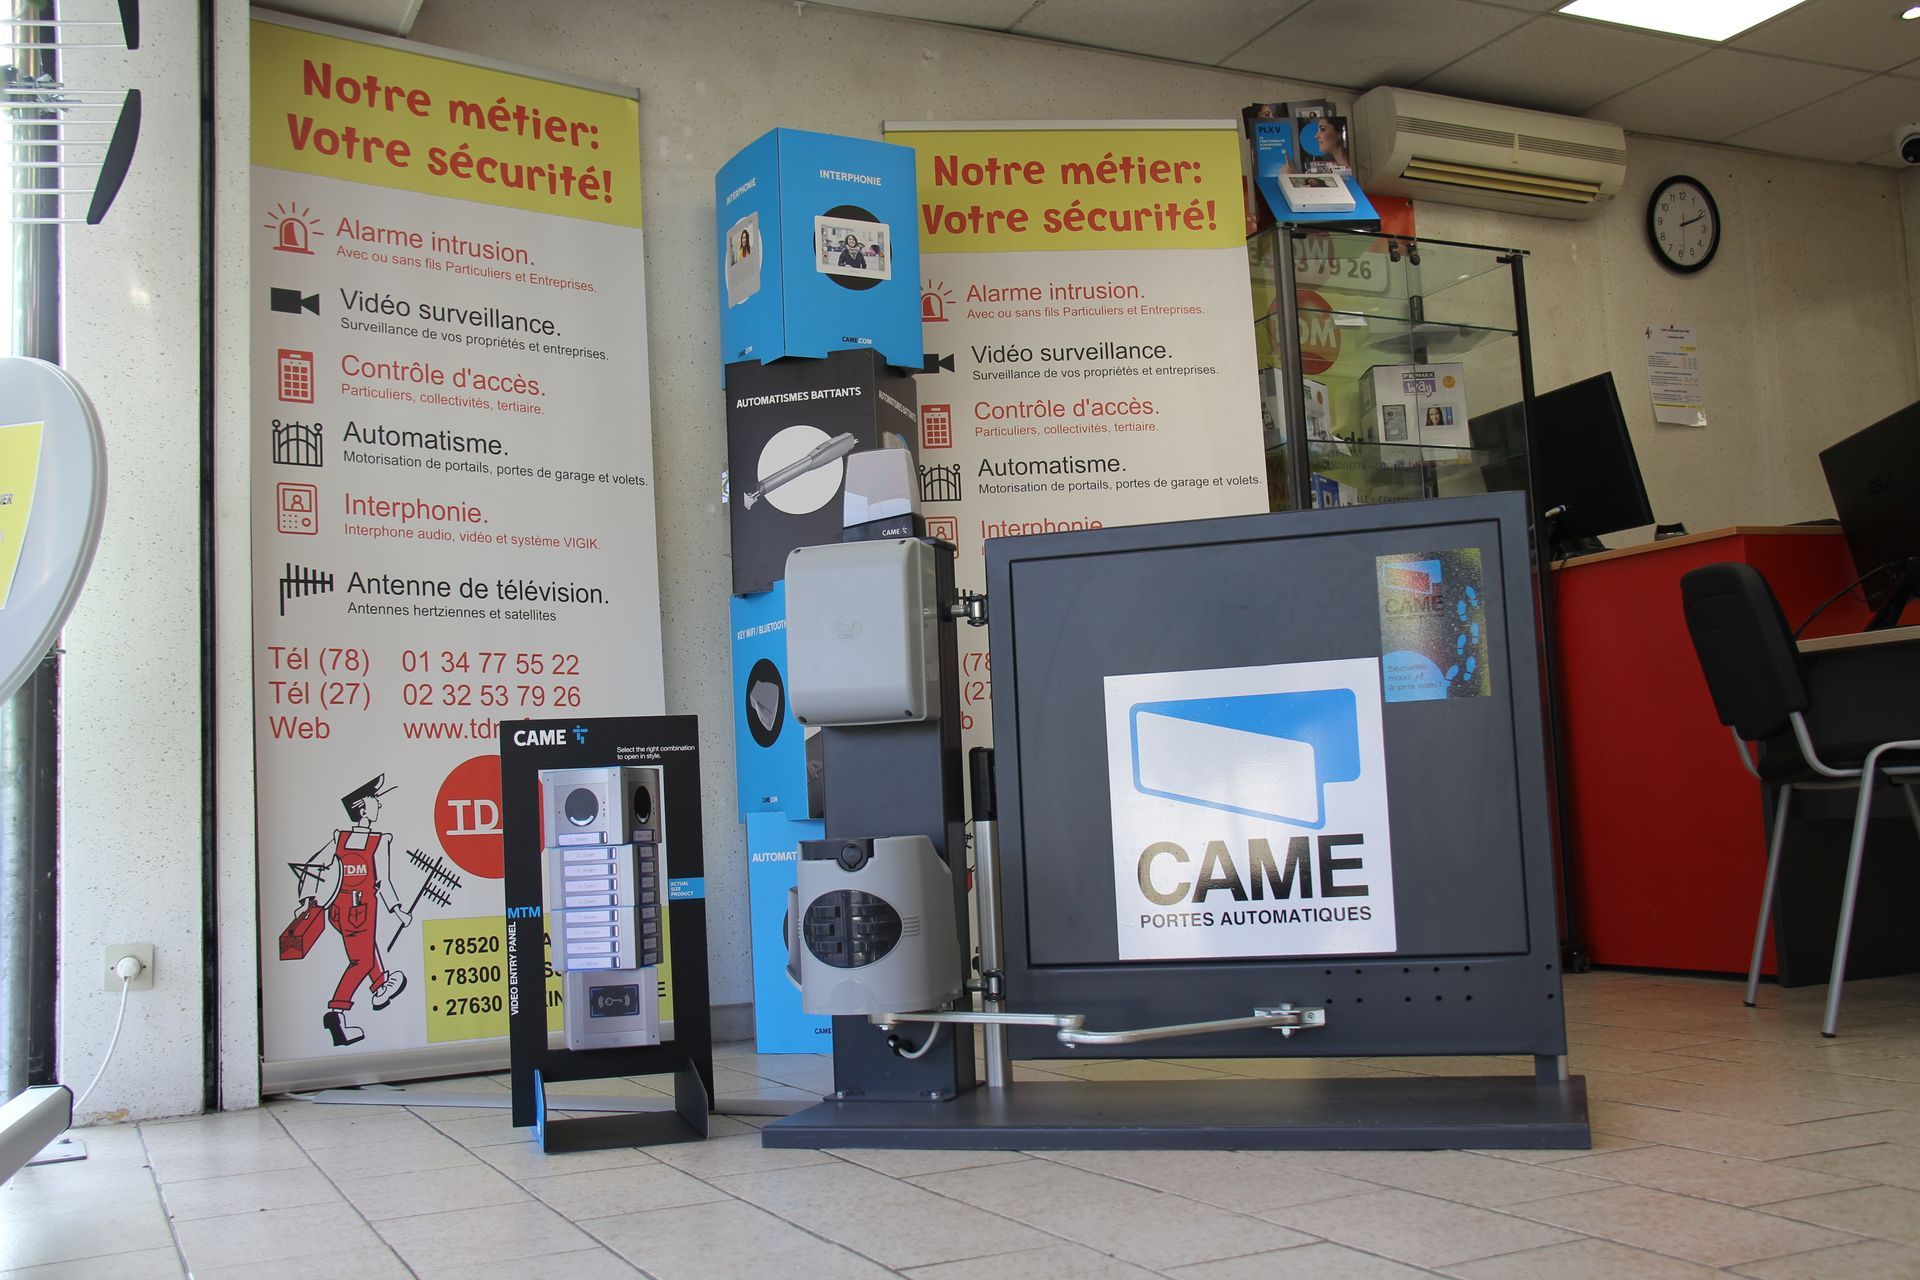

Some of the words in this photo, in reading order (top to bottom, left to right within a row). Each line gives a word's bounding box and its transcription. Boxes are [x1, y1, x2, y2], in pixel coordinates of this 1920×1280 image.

[303, 59, 431, 117] Notre
[449, 97, 599, 150] métier:
[1259, 126, 1274, 134] PLX
[287, 113, 411, 167] Votre
[428, 143, 612, 203] sécurité!
[934, 155, 1045, 187] Notre
[1061, 152, 1202, 185] métier:
[819, 168, 882, 187] INTERPHONIE
[726, 177, 756, 206] INTERPHONIE
[922, 203, 1029, 235] Votre
[1043, 199, 1217, 234] sécurité!
[336, 217, 422, 249] Alarme
[431, 231, 535, 265] intrusion.
[336, 246, 368, 261] Avec
[372, 252, 387, 264] ou
[391, 254, 421, 268] sans
[425, 256, 441, 271] fils
[445, 260, 512, 280] Particuliers
[515, 270, 527, 283] et
[529, 272, 597, 293] Entreprises.
[1347, 260, 1372, 280] 26
[966, 283, 1042, 302] Alarme
[1049, 282, 1145, 301] intrusion.
[340, 287, 411, 317] Vidéo
[419, 303, 561, 336] surveillance.
[967, 307, 995, 320] Avec
[997, 309, 1012, 319] ou
[1015, 308, 1042, 319] sans
[1044, 306, 1060, 318] fils
[1063, 305, 1124, 318] Particuliers
[1126, 305, 1138, 316] et
[1140, 304, 1205, 319] Entreprises.
[341, 317, 418, 337] Surveillance
[422, 326, 437, 339] de
[441, 330, 462, 342] vos
[466, 331, 525, 353] propriétés
[529, 339, 540, 353] et
[542, 341, 609, 362] entreprises.
[842, 335, 872, 345] CAME.COM
[971, 344, 1034, 364] Vidéo
[1040, 342, 1173, 363] surveillance.
[341, 354, 445, 385] Contrôle
[453, 367, 546, 397] d'accès.
[972, 367, 1041, 381] Surveillance
[1044, 368, 1058, 379] de
[1060, 369, 1081, 379] vos
[1083, 365, 1139, 379] propriétés
[1142, 366, 1153, 377] et
[1156, 364, 1219, 379] entreprises.
[341, 383, 416, 403] Particuliers,
[420, 392, 493, 412] collectivités,
[497, 400, 544, 415] tertiaire.
[736, 391, 809, 409] AUTOMATISMES
[811, 386, 862, 401] BATTANTS
[974, 400, 1065, 420] Contrôle
[1073, 397, 1160, 417] d'accès.
[343, 421, 509, 456] Automatisme.
[975, 424, 1040, 438] Particuliers,
[1044, 422, 1111, 437] collectivités,
[1114, 421, 1159, 433] tertiaire.
[344, 450, 421, 468] Motorisation
[425, 455, 441, 469] de
[445, 458, 493, 477] portails,
[497, 463, 533, 478] portes
[537, 466, 551, 479] de
[555, 470, 595, 484] garage
[599, 471, 610, 484] et
[612, 472, 649, 487] volets.
[978, 455, 1127, 478] Automatisme.
[979, 481, 1048, 494] Motorisation
[1050, 481, 1065, 492] de
[1068, 479, 1112, 493] portails,
[1115, 478, 1151, 491] portes
[1153, 477, 1168, 488] de
[1171, 478, 1209, 490] garage
[1212, 476, 1223, 487] et
[1226, 475, 1262, 488] volets.
[344, 493, 488, 524] Interphonie.
[344, 523, 414, 541] Interphone
[418, 527, 456, 543] audio,
[460, 529, 492, 543] vidéo
[496, 532, 508, 545] et
[511, 533, 560, 551] système
[564, 535, 602, 551] VIGIK.
[882, 528, 900, 537] CAME
[347, 571, 451, 598] Antenne
[459, 576, 488, 600] de
[496, 577, 610, 605] télévision.
[347, 602, 409, 617] Antennes
[413, 604, 486, 619] hertziennes
[489, 607, 501, 620] et
[504, 607, 557, 622] satellites
[737, 630, 745, 640] KEY
[746, 627, 756, 639] WIFI
[268, 646, 309, 670] Tél
[319, 648, 370, 676] (78)
[402, 650, 430, 672] 01
[441, 651, 470, 673] 34
[478, 652, 508, 674] 77
[516, 653, 544, 675] 55
[552, 653, 580, 676] 22
[268, 681, 309, 705] Tél
[319, 682, 371, 711] (27)
[403, 683, 433, 706] 02
[442, 684, 472, 706] 32
[480, 684, 509, 707] 53
[517, 685, 545, 707] 79
[552, 685, 581, 708] 26
[269, 716, 330, 740] Web
[513, 729, 567, 747] CAME
[616, 745, 635, 754] Select
[646, 745, 660, 754] right
[660, 744, 695, 753] combination
[647, 753, 662, 761] style.
[447, 799, 500, 831] TD
[1137, 833, 1369, 906] CAME
[507, 906, 541, 919] MTM
[1140, 912, 1215, 928] PORTES
[1221, 906, 1372, 926] AUTOMATIQUES
[443, 936, 500, 956] 78520
[508, 921, 517, 953] PANEL
[444, 965, 501, 986] 78300
[509, 954, 518, 985] ENTRY
[446, 995, 503, 1016] 27630
[510, 986, 519, 1016] VIDEO
